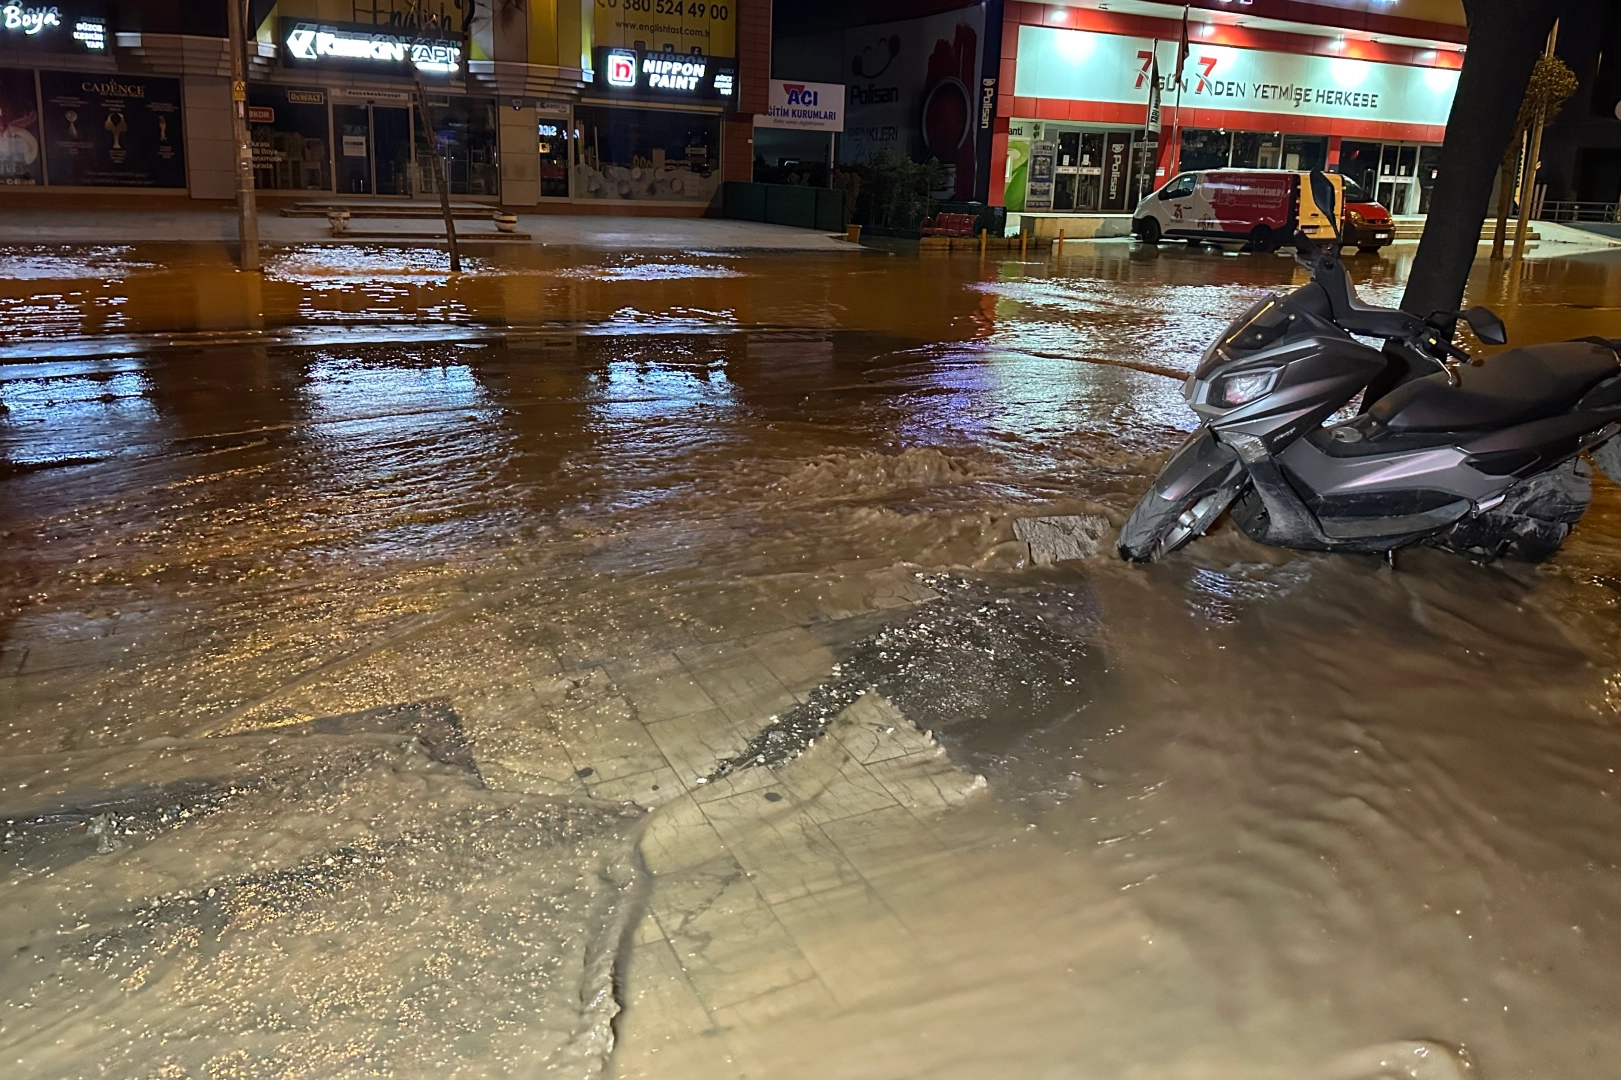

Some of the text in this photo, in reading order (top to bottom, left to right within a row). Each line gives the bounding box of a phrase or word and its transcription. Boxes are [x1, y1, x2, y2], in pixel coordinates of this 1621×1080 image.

[3, 5, 60, 34] Boya
[656, 0, 683, 16] 524
[688, 2, 706, 18] 49
[710, 4, 728, 20] 00
[615, 20, 710, 38] www.englishfast.com.tr
[643, 59, 706, 78] NIPPON
[81, 81, 146, 96] CADENCE
[649, 73, 699, 90] PAINT
[787, 90, 818, 106] AÇI
[1214, 81, 1246, 98] DEN
[1315, 89, 1379, 108] HERKESE
[763, 105, 837, 120] ĞİTİM KURUMLARI
[981, 88, 994, 129] Polisan
[1109, 155, 1122, 200] Polisan
